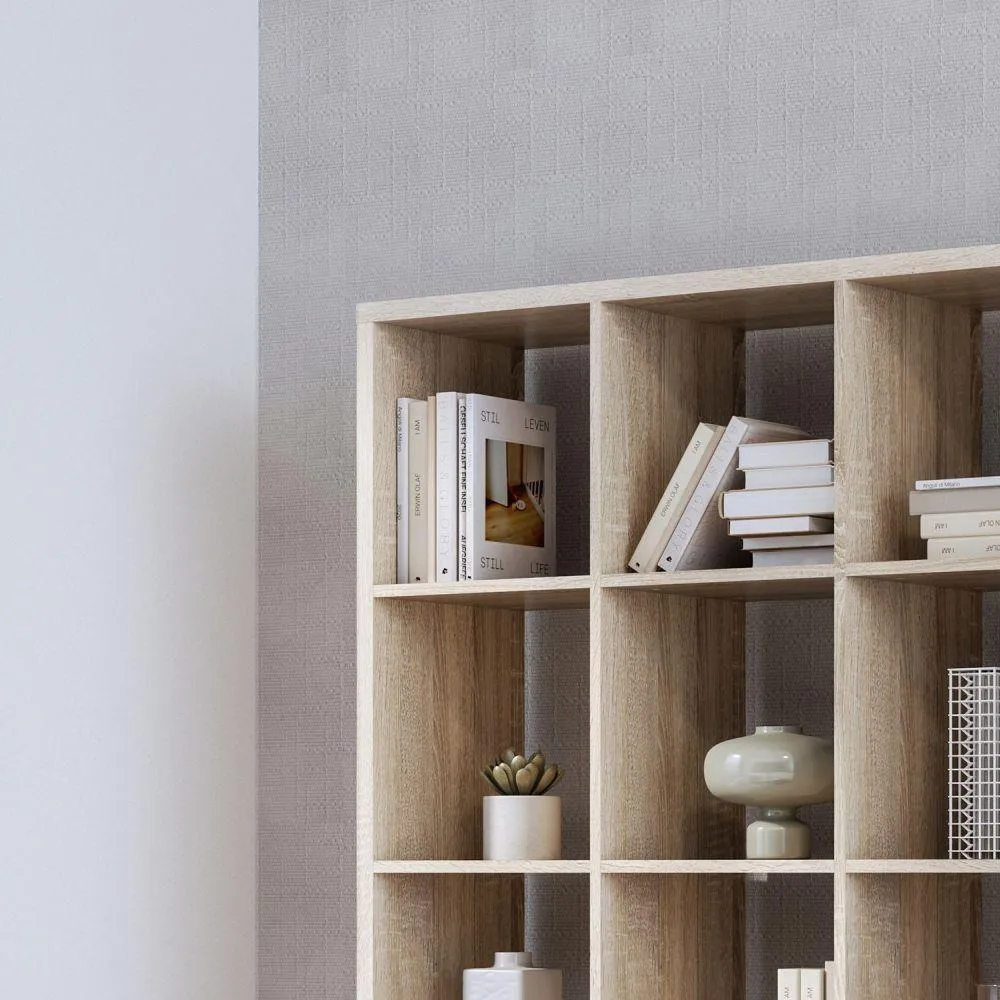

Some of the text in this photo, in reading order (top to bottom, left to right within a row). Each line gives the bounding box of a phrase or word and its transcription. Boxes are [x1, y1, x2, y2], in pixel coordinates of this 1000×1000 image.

[414, 420, 421, 431] AM
[480, 409, 550, 432] STIL LEVEN
[978, 520, 995, 528] OLAF
[480, 556, 549, 575] STILL LIFE
